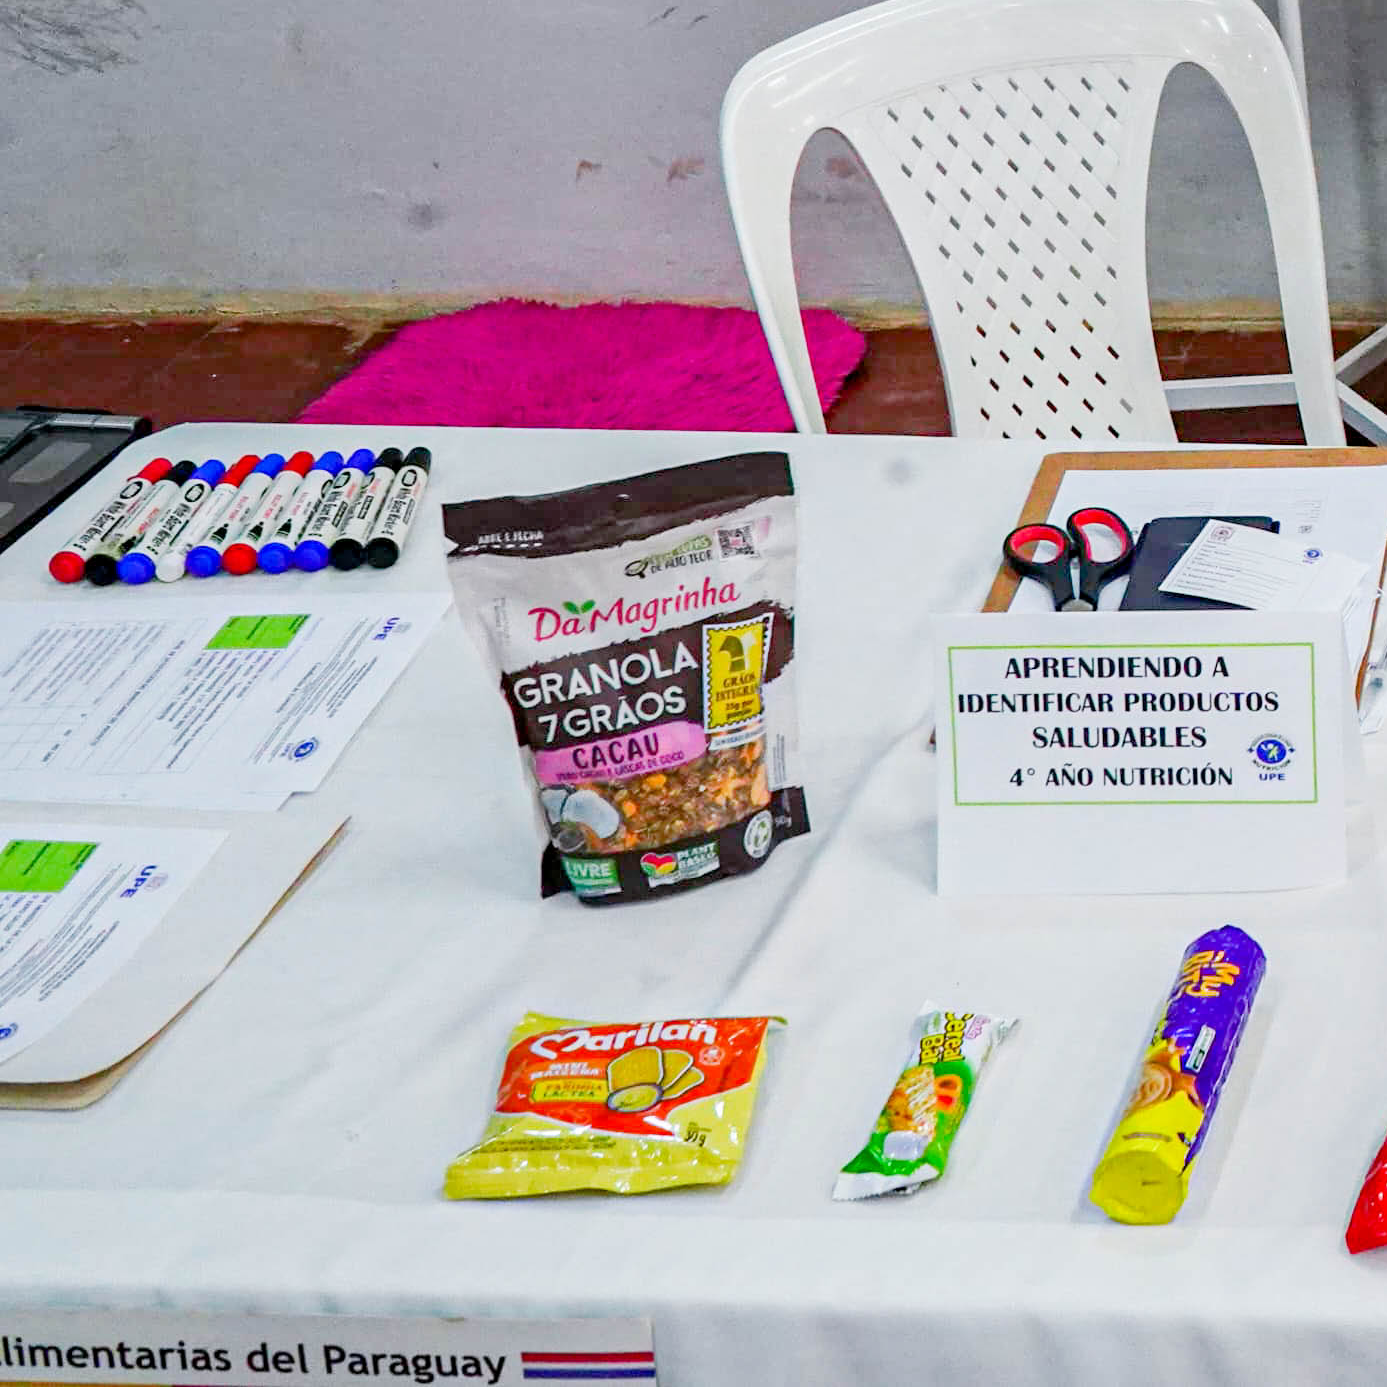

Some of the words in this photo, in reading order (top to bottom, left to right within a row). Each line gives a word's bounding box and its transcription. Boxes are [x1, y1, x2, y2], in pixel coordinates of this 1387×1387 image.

[513, 641, 699, 710] GRANOLA
[1004, 656, 1202, 680] APRENDIENDO
[1212, 656, 1230, 677] A
[538, 715, 558, 743] 7
[563, 685, 687, 738] GRÃOS
[957, 693, 1114, 714] IDENTIFICAR
[1124, 691, 1280, 713] PRODUCTOS
[1032, 726, 1208, 749] SALUDABLES
[572, 732, 660, 769] CACAU
[1009, 767, 1037, 787] 4°
[1045, 764, 1095, 787] AÑO
[1102, 762, 1234, 787] NUTRICIÓN
[1259, 772, 1287, 781] UPE
[0, 1336, 231, 1373] limentarias
[247, 1342, 308, 1374] del
[323, 1345, 506, 1384] Paraguay
